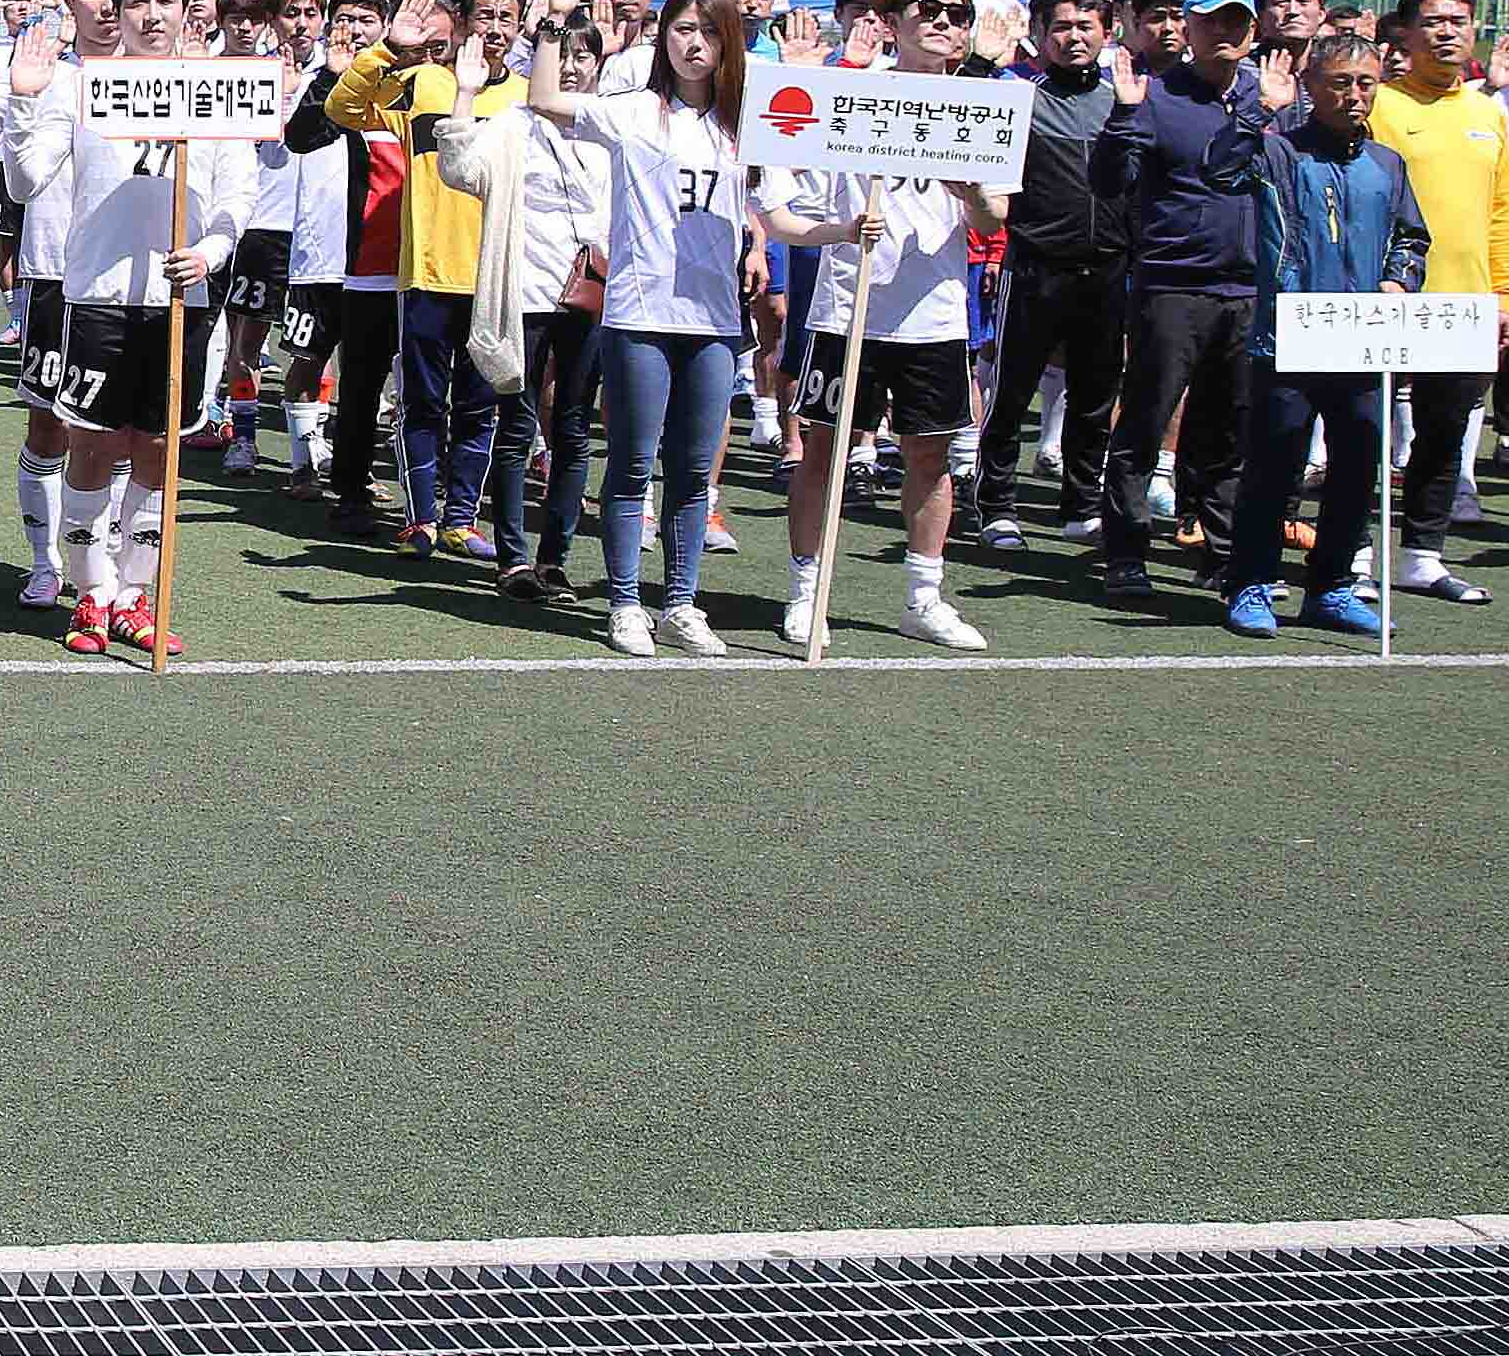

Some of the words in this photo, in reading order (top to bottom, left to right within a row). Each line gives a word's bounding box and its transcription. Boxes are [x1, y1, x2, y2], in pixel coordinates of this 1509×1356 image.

[90, 77, 275, 118] 한국산업기술대학교
[833, 94, 1014, 126] 한국지역난방공사
[133, 140, 175, 176] 27
[826, 142, 863, 155] korea
[867, 143, 916, 158] district
[920, 146, 970, 163] heating
[975, 152, 1009, 165] corp.
[679, 168, 719, 212] 37
[230, 275, 267, 309] 23
[284, 306, 316, 348] 98
[1294, 300, 1481, 331] 한국가스기술공사
[23, 346, 62, 388] 20
[1362, 347, 1409, 365] ACE
[60, 363, 107, 410] 27
[804, 368, 844, 414] 90
